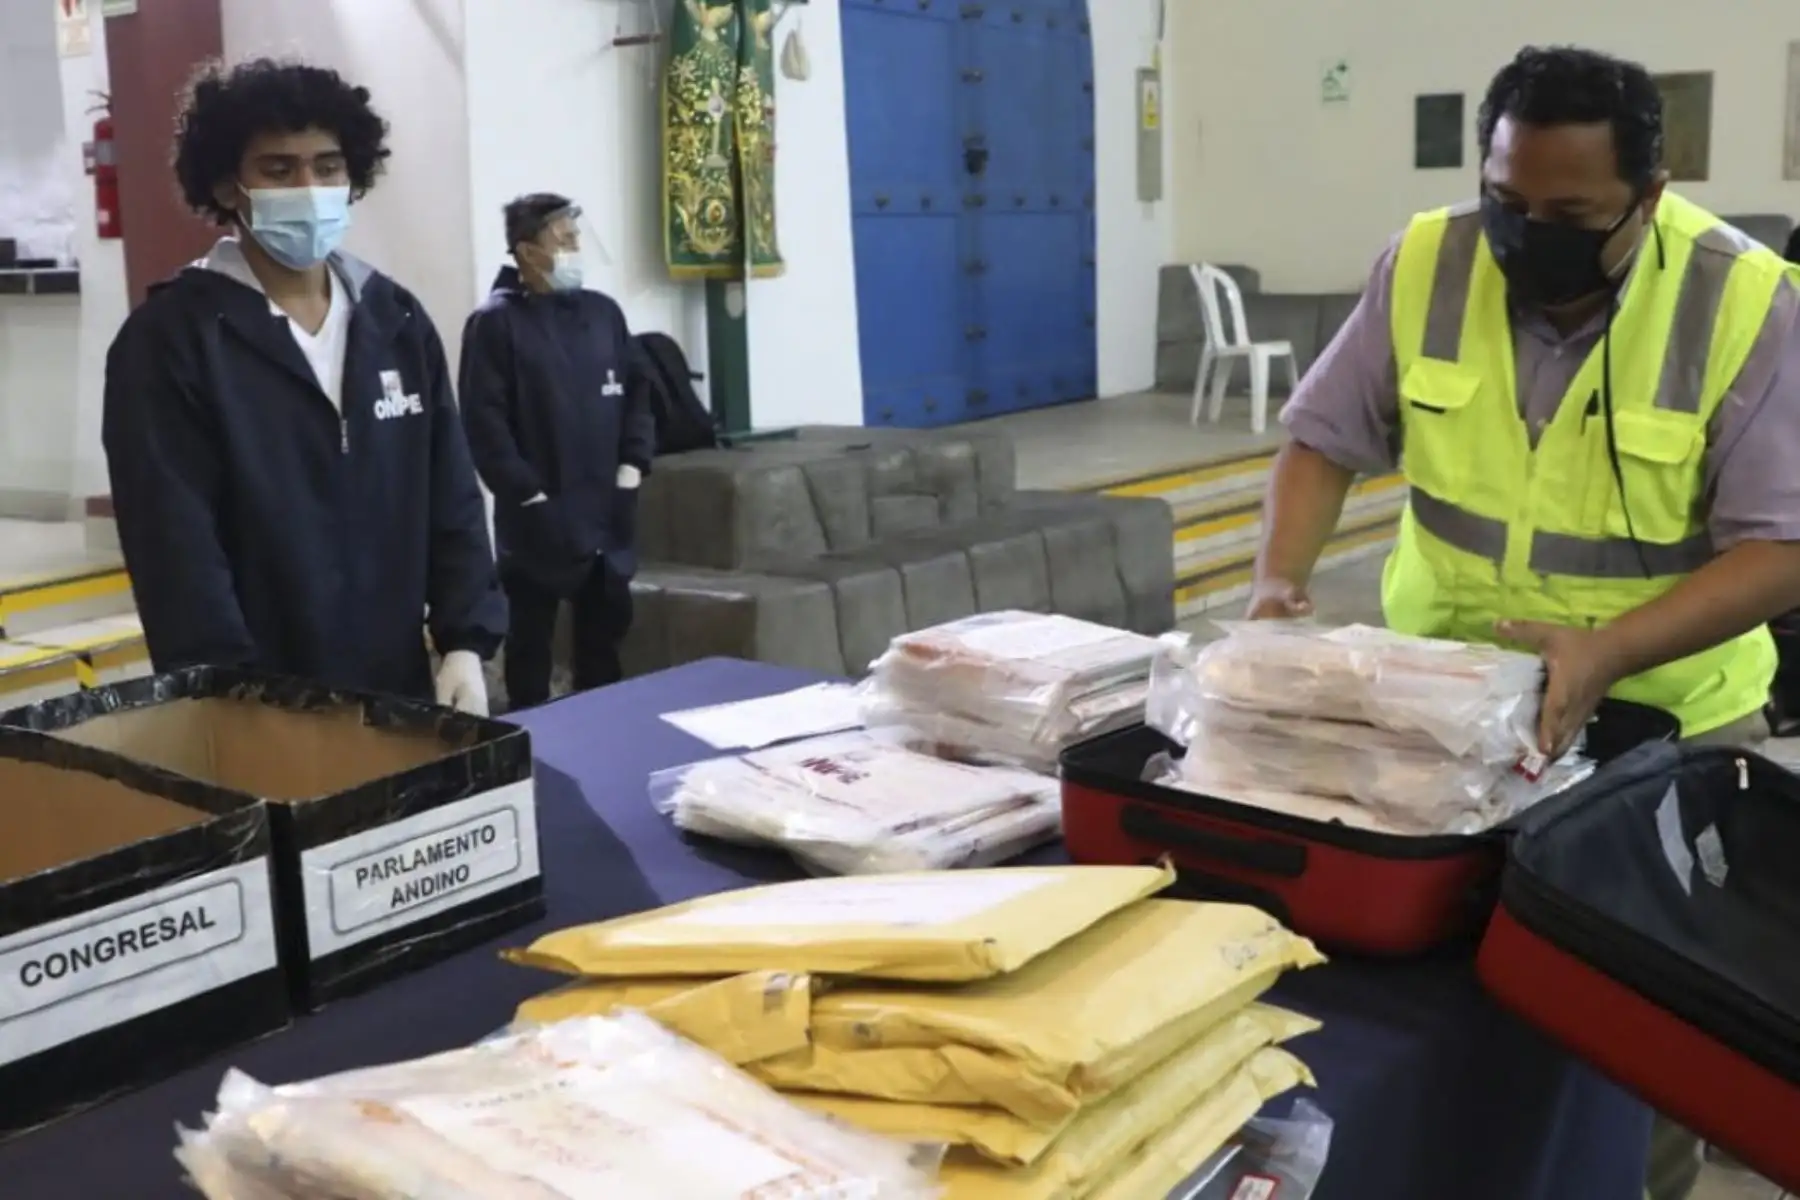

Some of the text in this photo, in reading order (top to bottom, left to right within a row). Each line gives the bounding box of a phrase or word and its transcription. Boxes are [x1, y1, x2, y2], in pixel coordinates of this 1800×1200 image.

[374, 393, 424, 420] ONPE
[355, 824, 496, 890] PARLAMENTO
[390, 864, 470, 908] ANDINO
[20, 906, 216, 987] CONGRESAL
